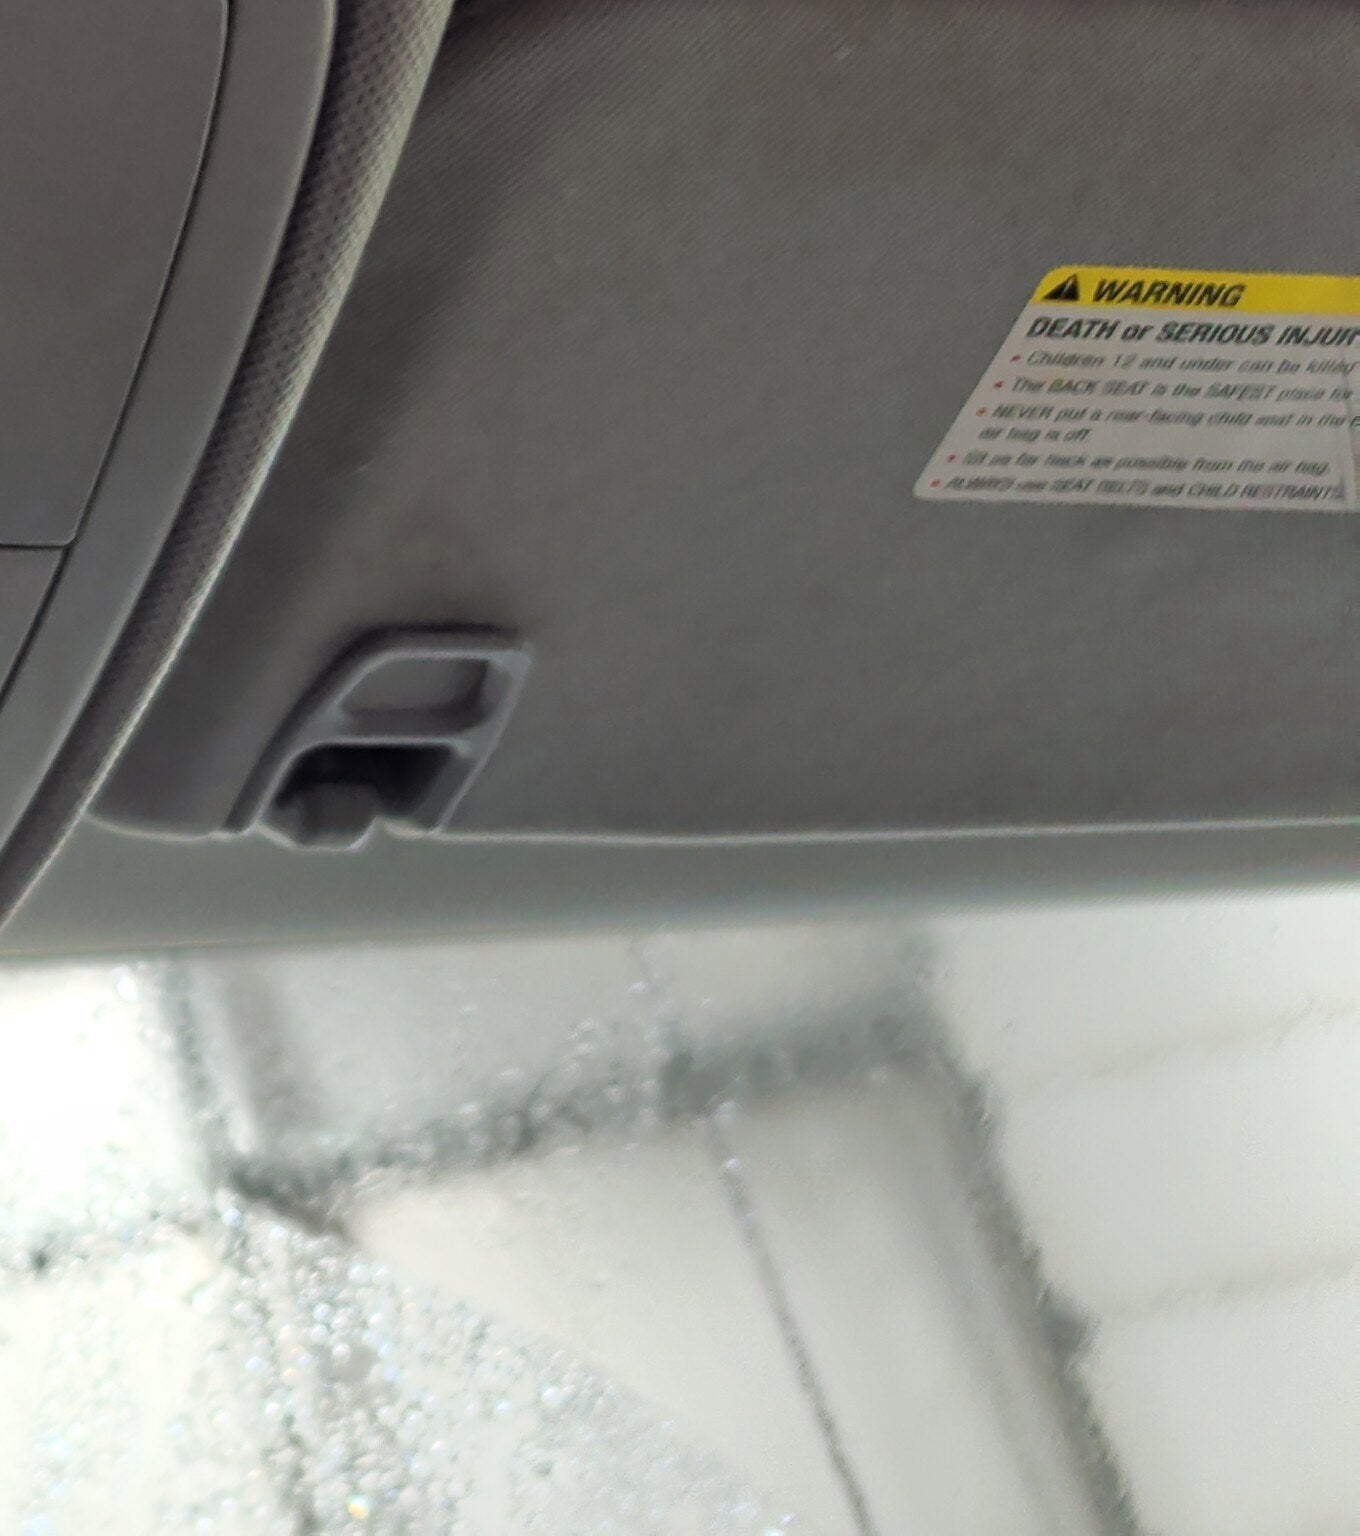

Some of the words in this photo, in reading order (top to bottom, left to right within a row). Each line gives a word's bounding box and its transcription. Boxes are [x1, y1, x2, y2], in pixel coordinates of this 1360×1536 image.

[1093, 279, 1247, 307] WARNING
[1026, 317, 1120, 341] DEATH
[1121, 323, 1154, 341] or
[1155, 320, 1276, 346] SERIOUS
[1027, 350, 1104, 367] Children
